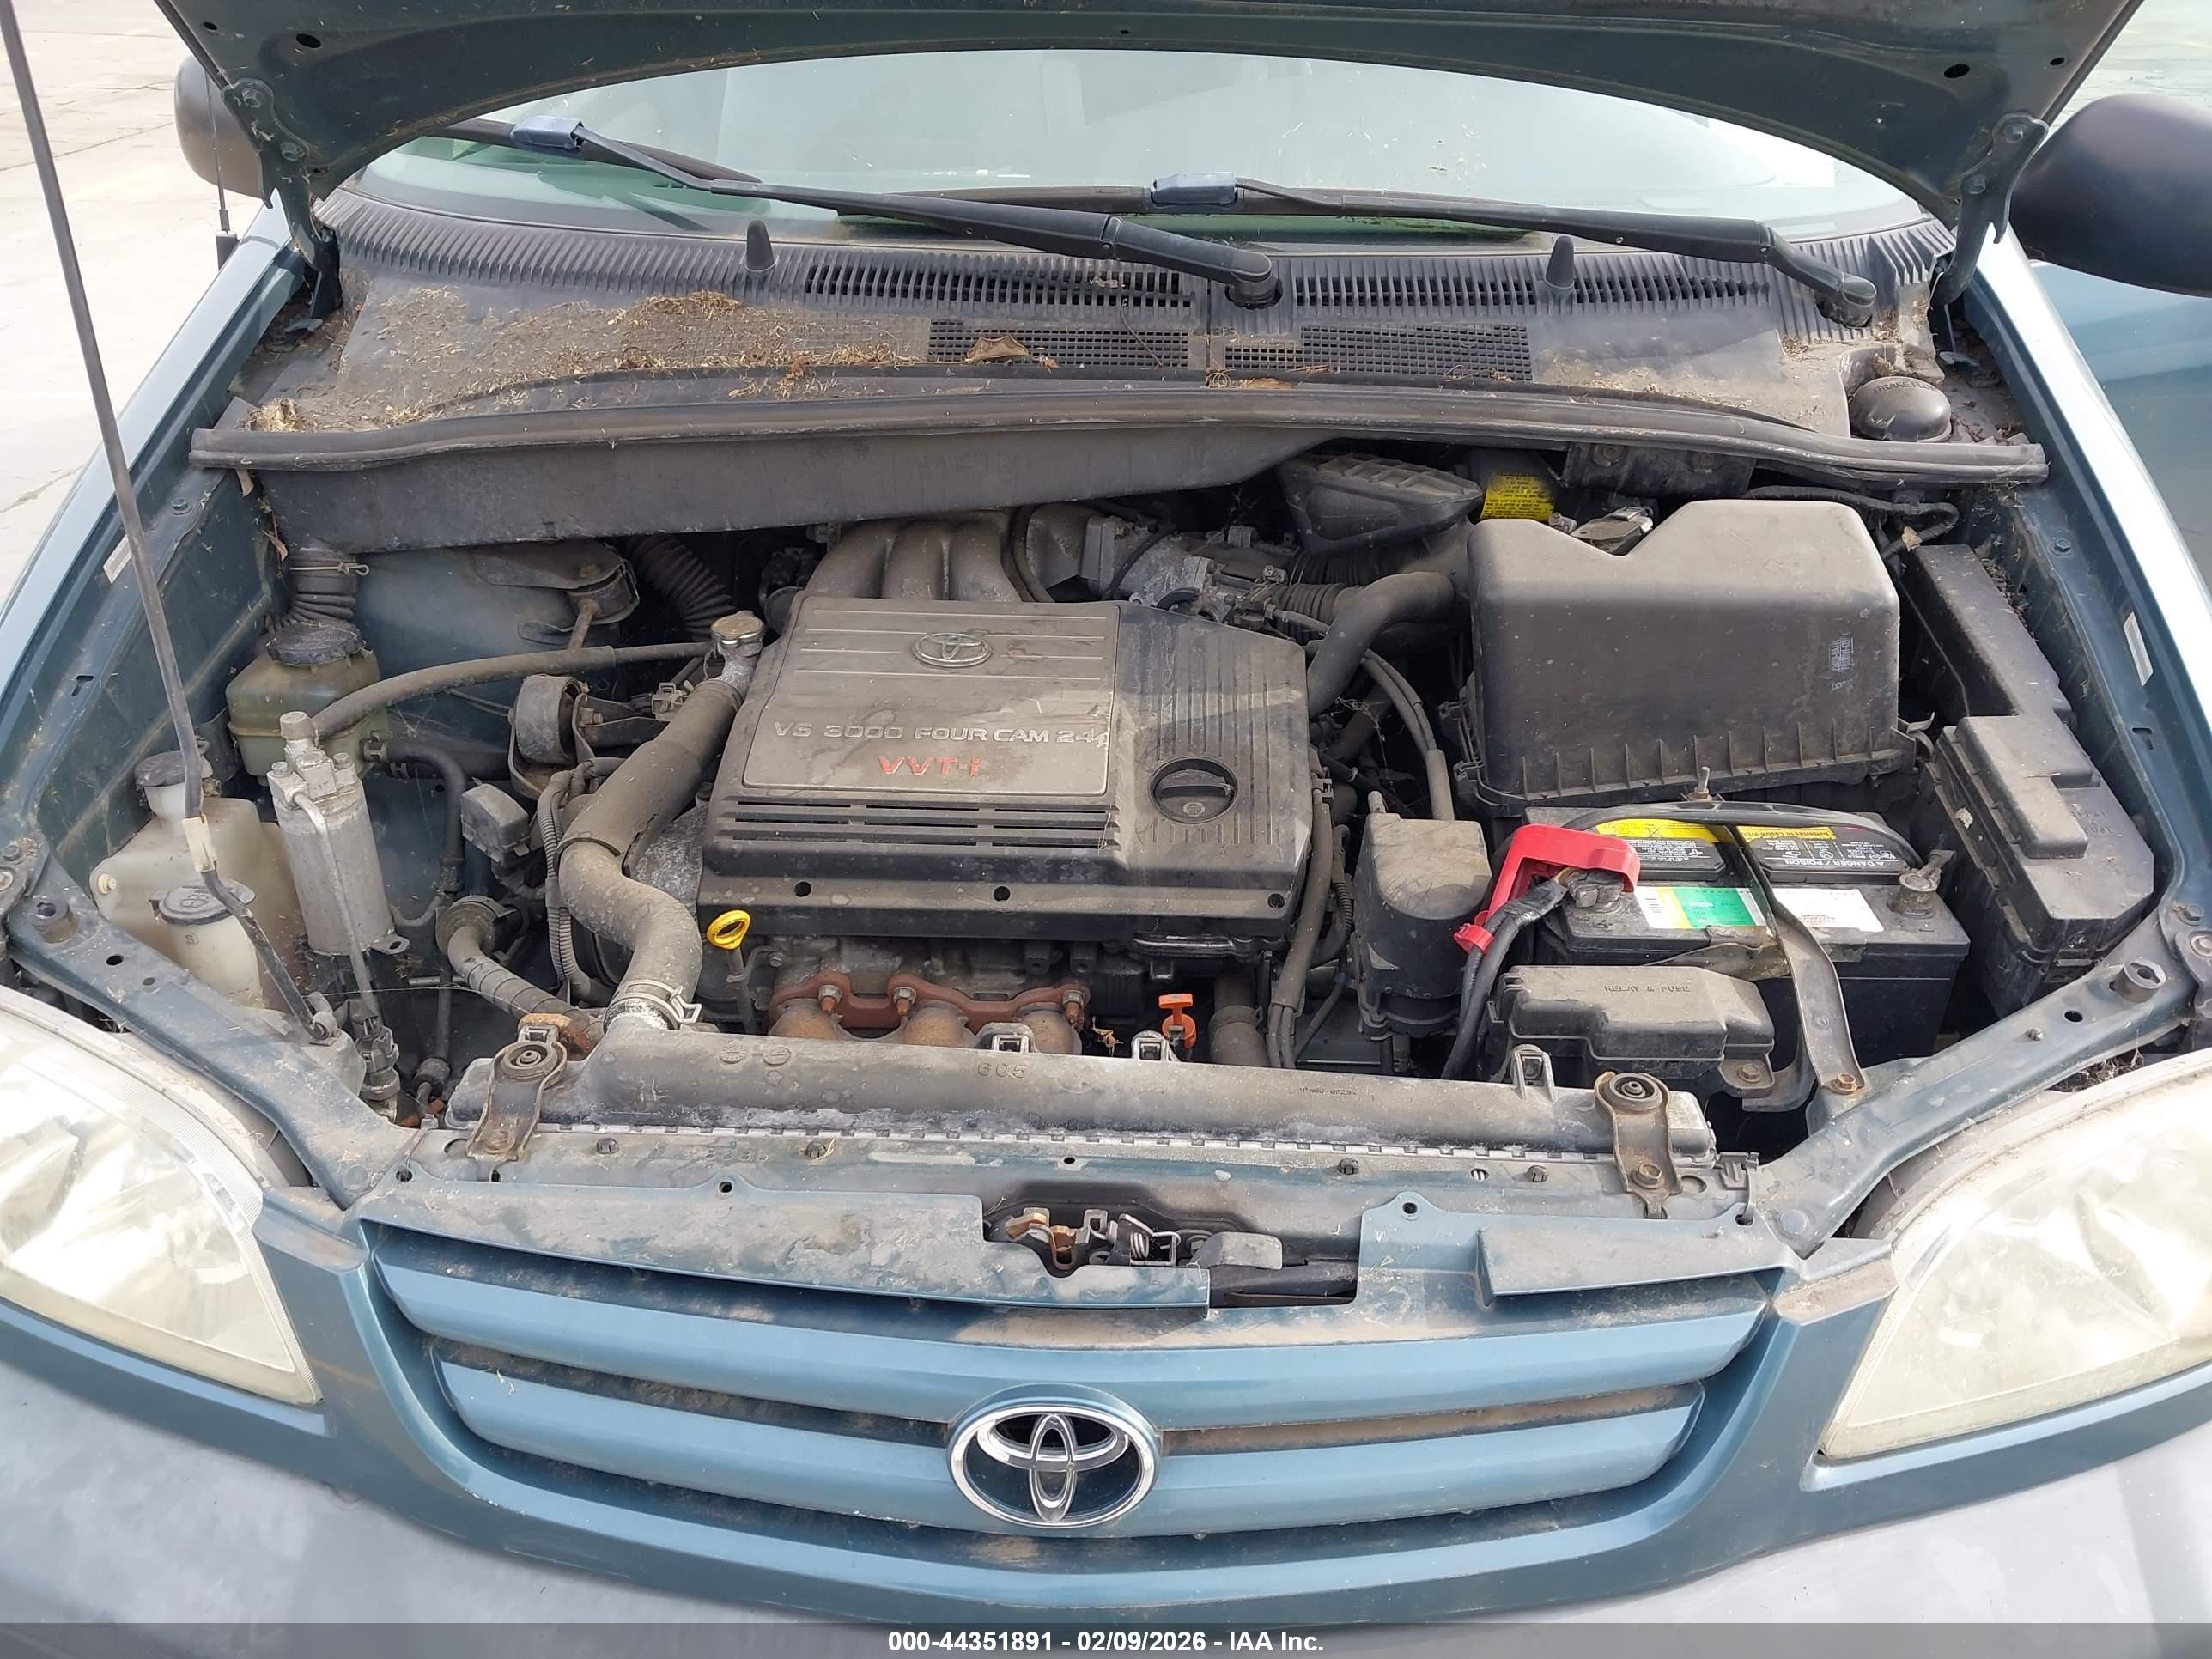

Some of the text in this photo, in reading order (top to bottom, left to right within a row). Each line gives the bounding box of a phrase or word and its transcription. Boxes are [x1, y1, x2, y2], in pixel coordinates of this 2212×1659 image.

[1874, 380, 1911, 393] BRAKE
[775, 721, 811, 738] V6
[824, 725, 904, 740] 3000
[915, 726, 988, 742] FOUR
[994, 728, 1049, 743] CAM
[878, 755, 981, 778] VVT-i
[1603, 984, 1640, 993] RELAY
[1661, 985, 1691, 994] FUSE
[977, 1062, 1028, 1079] 605
